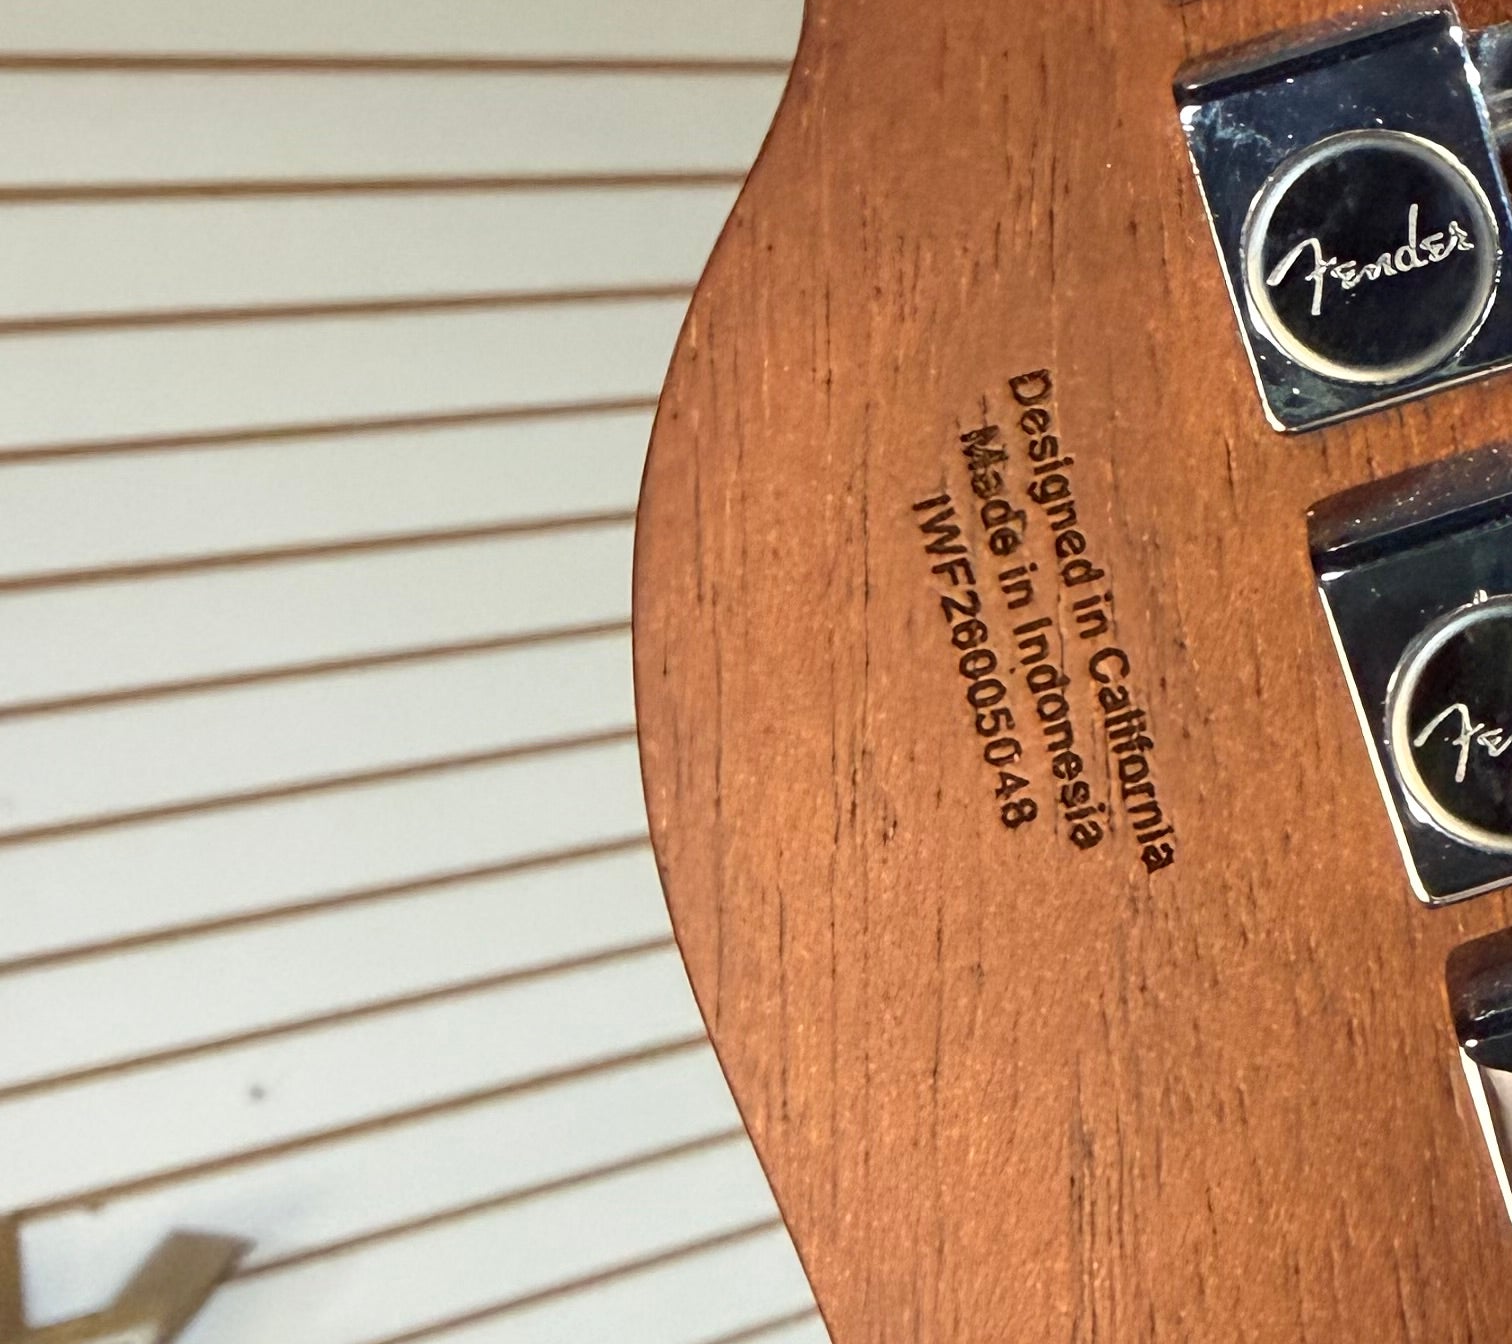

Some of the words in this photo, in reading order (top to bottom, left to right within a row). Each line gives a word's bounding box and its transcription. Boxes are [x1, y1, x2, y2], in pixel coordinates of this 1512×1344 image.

[1265, 203, 1475, 317] Fender
[959, 423, 1028, 557] Made
[1007, 367, 1105, 589] Designed
[998, 562, 1039, 610] in
[1072, 591, 1113, 640] in
[1012, 616, 1106, 851] Indonesia
[1087, 646, 1175, 874] California
